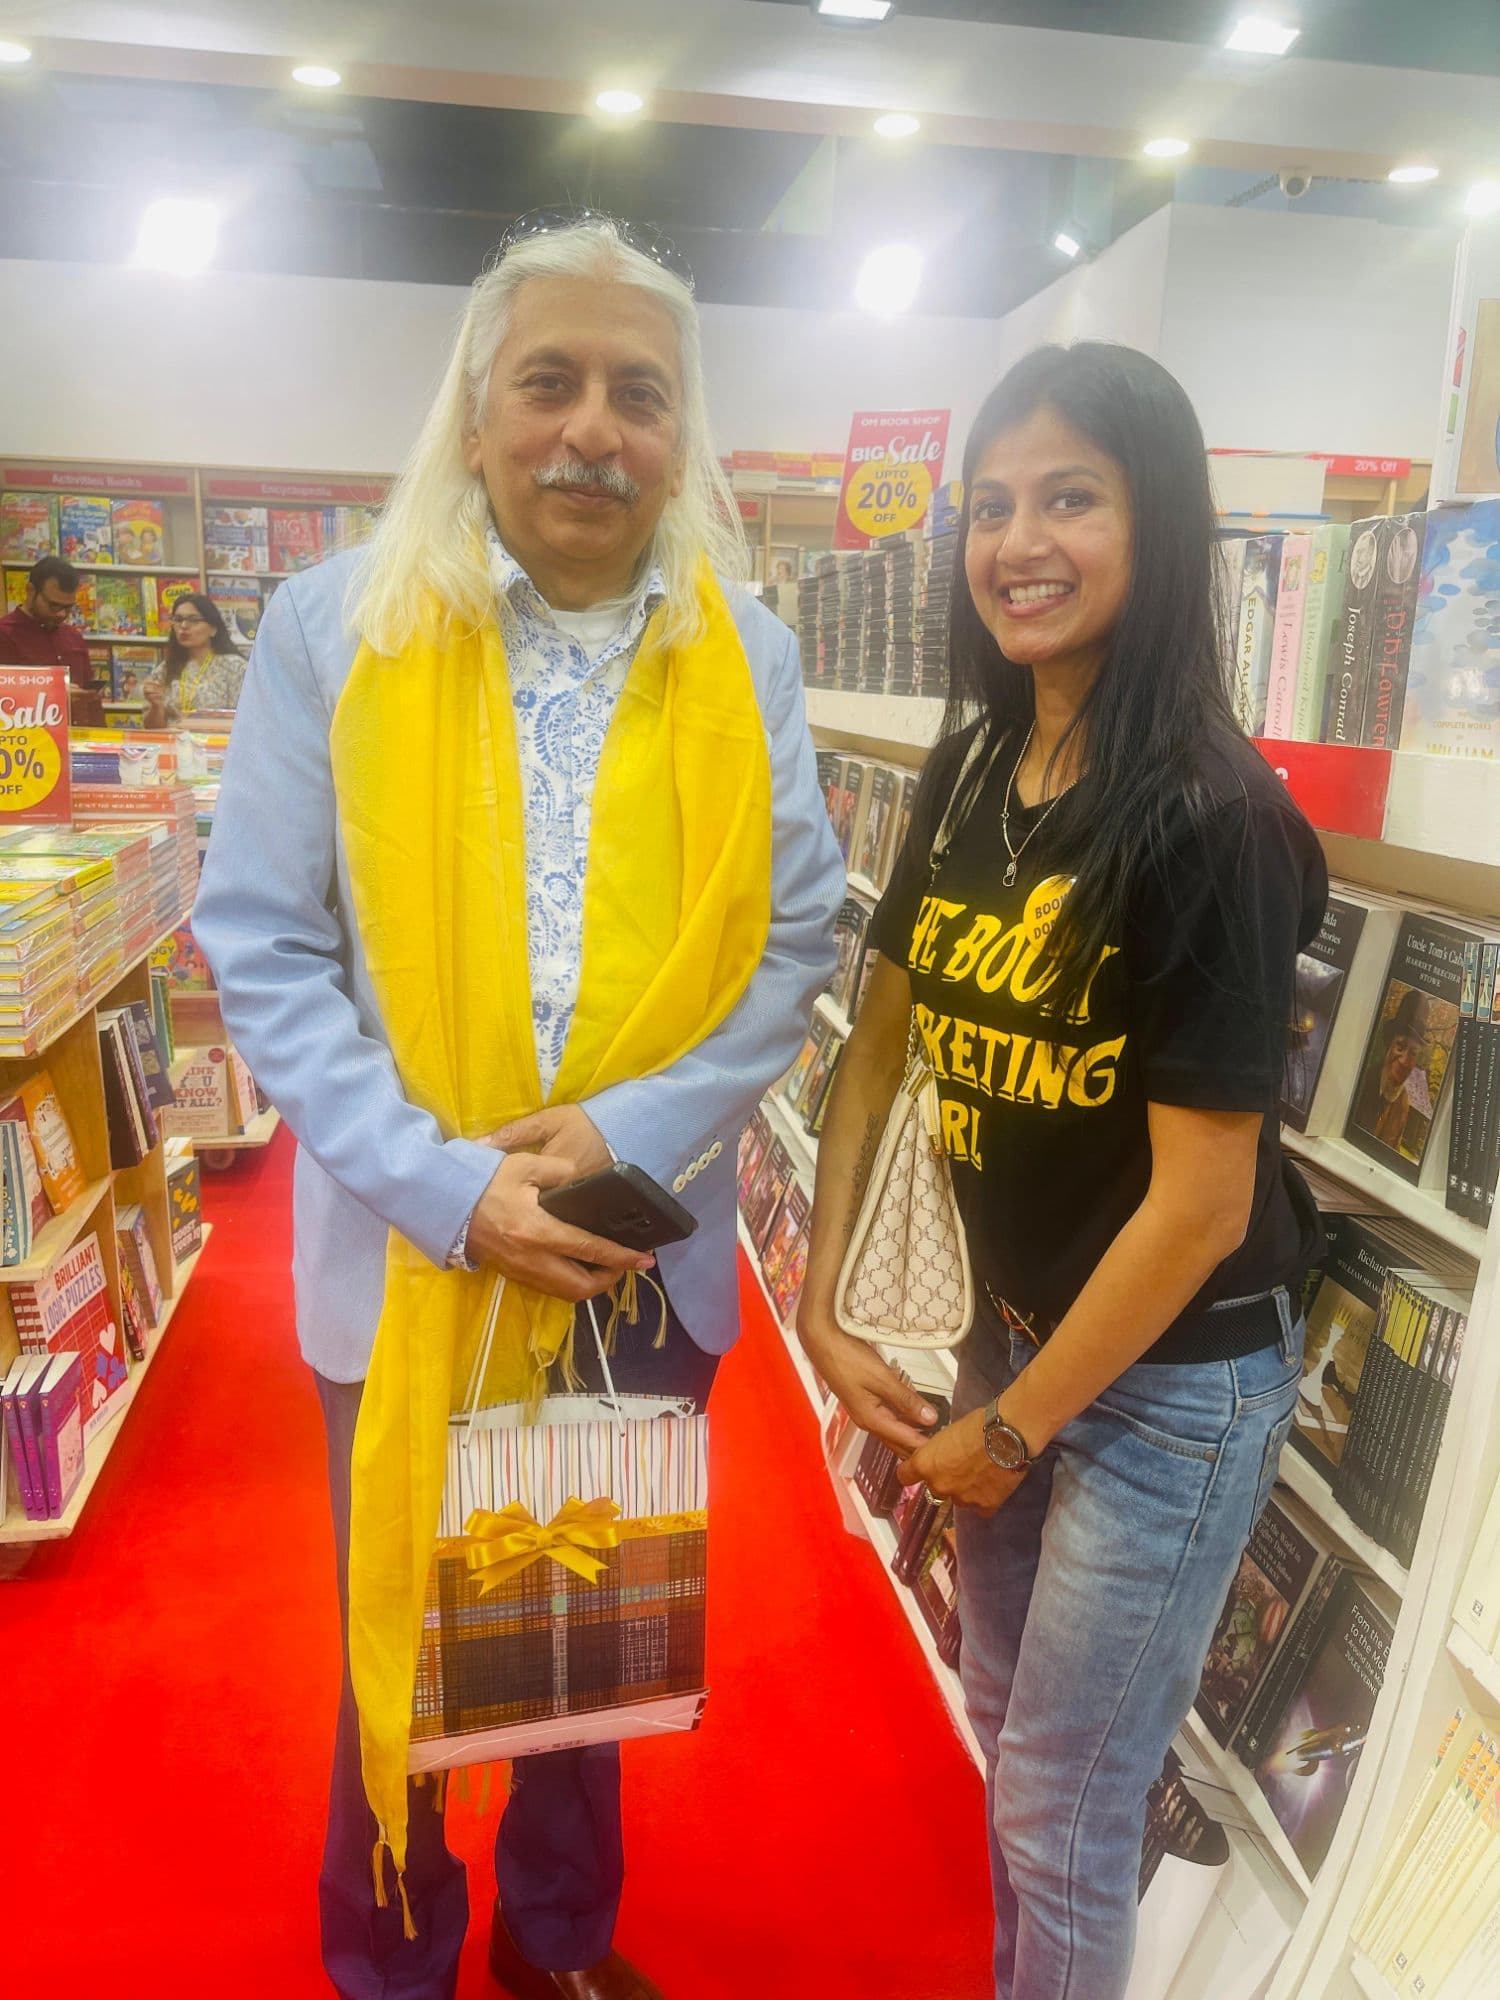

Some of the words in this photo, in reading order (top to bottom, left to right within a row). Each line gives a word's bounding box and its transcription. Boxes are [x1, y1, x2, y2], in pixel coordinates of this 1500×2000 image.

[880, 417, 910, 426] BOOK
[912, 416, 940, 425] SHOP
[851, 446, 884, 462] BIG
[888, 431, 941, 465] Sale
[875, 470, 909, 480] UPTO
[1355, 460, 1378, 472] 20%
[1381, 461, 1398, 473] Off
[107, 476, 143, 488] Books
[261, 484, 332, 496] Encyclopedia
[857, 481, 917, 509] 20%
[873, 513, 896, 522] OFF
[1243, 597, 1257, 655] EDGAR
[1343, 606, 1361, 666] Joseph
[1280, 621, 1293, 672] Lewis
[19, 676, 54, 685] SHOP
[0, 691, 64, 731] Sale
[1273, 676, 1287, 739] Carroll
[1335, 672, 1353, 742] Conrad
[1432, 720, 1465, 729] COMPLETE
[1467, 721, 1491, 730] WORKS
[1033, 921, 1055, 940] DO
[1320, 928, 1341, 944] Stories
[1407, 934, 1427, 952] Uncle
[1429, 942, 1449, 960] Tom's
[941, 914, 1121, 1025] BOO
[1406, 956, 1432, 972] HARRIET
[1433, 966, 1461, 984] BEECHER
[1419, 973, 1440, 987] STOWE
[175, 1088, 218, 1098] KNOW
[190, 1098, 222, 1108] ALL?
[941, 1099, 982, 1172] RL
[173, 1219, 196, 1244] BOOST
[174, 1232, 193, 1254] YOUR
[54, 1242, 97, 1291] BRILLIANT
[1338, 1259, 1363, 1281] WILLIAM
[1357, 1248, 1388, 1277] Richard
[44, 1294, 67, 1335] LOGIC
[65, 1263, 103, 1312] PUZZLES
[1350, 1623, 1359, 1637] to
[1358, 1634, 1371, 1654] the
[1351, 1604, 1370, 1632] From
[1370, 1629, 1383, 1650] the
[1347, 1640, 1366, 1663] Around
[1365, 1661, 1375, 1675] the
[1345, 1650, 1360, 1673] JULES
[1360, 1671, 1378, 1696] VERNE
